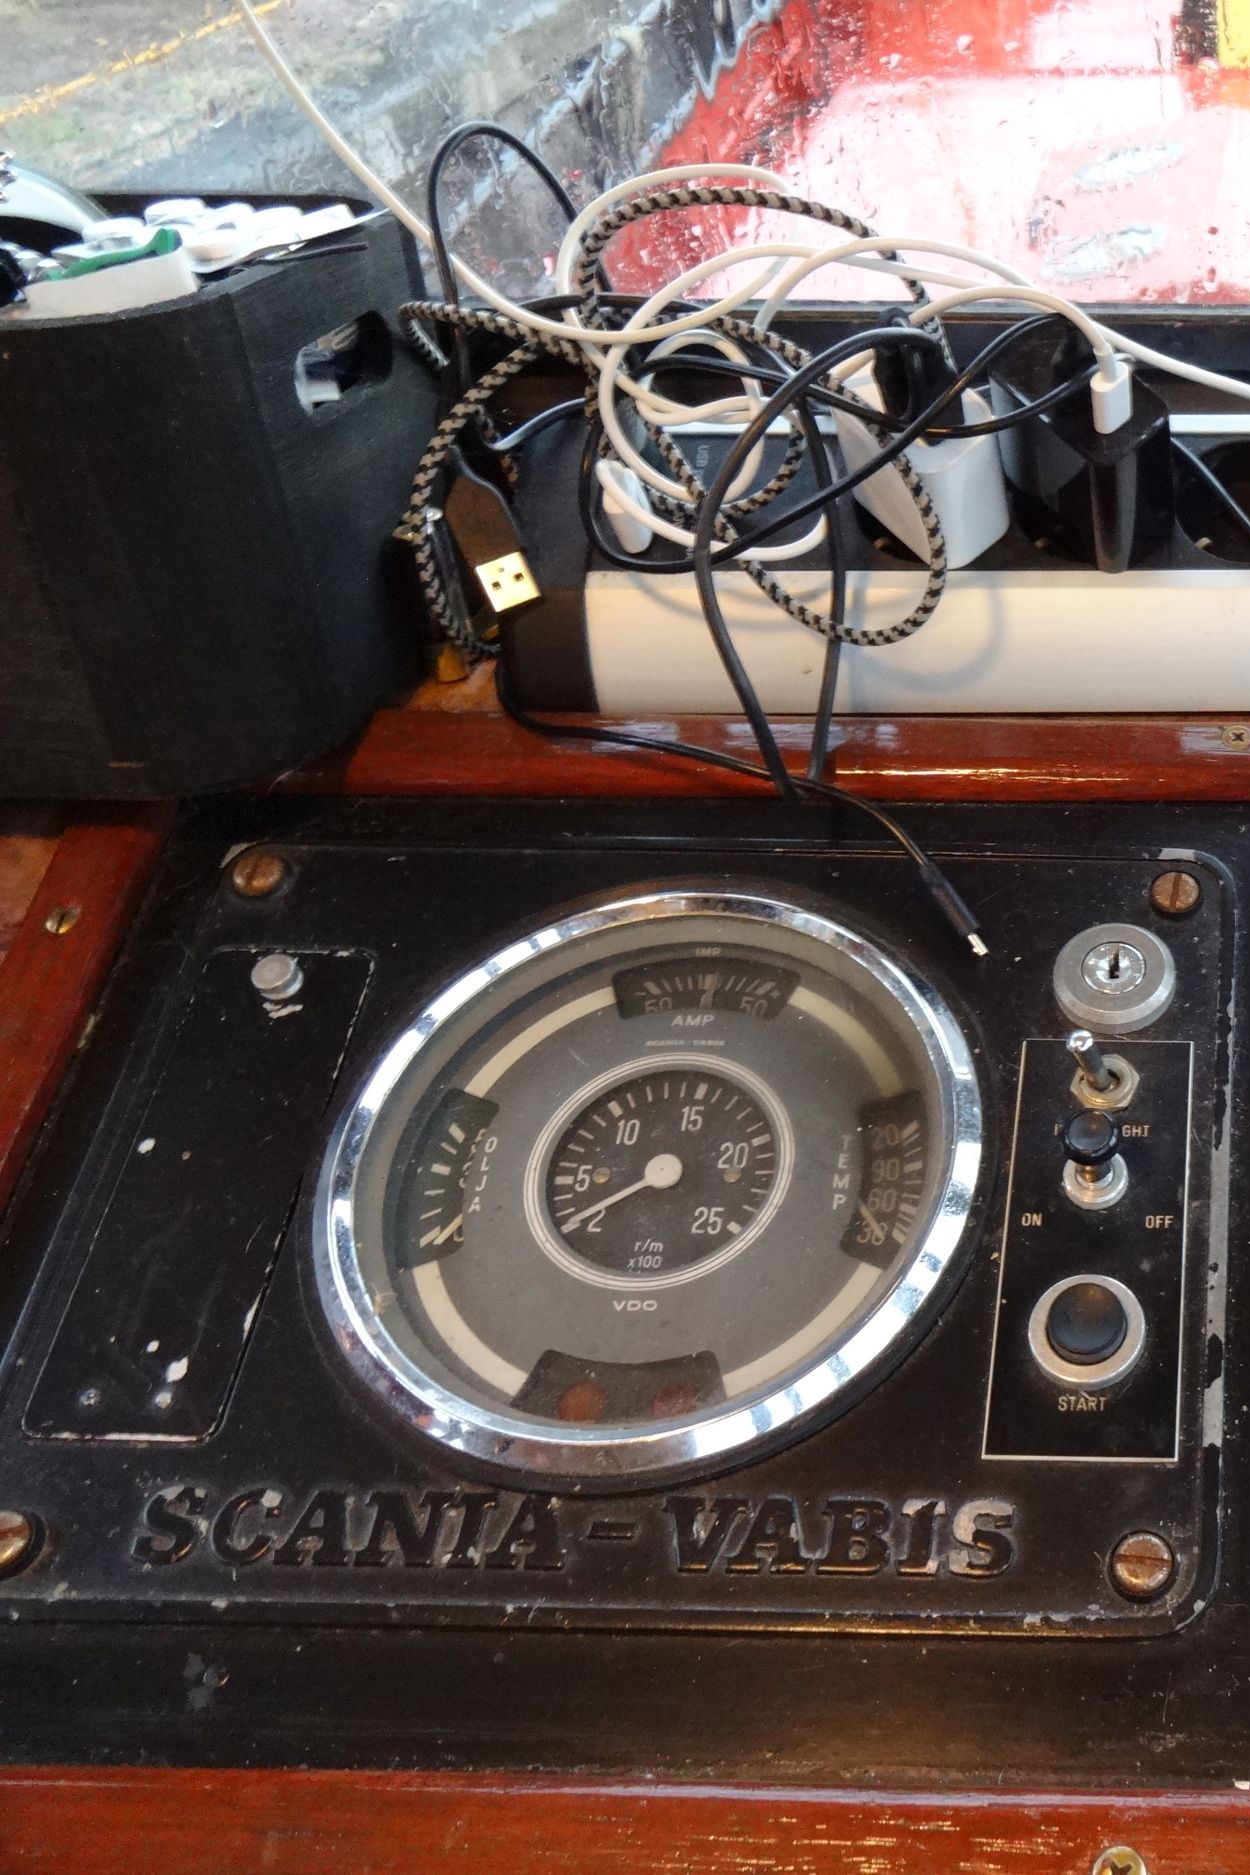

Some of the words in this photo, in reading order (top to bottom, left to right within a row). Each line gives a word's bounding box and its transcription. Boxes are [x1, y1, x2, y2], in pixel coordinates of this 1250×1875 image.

[739, 996, 769, 1016] 50
[671, 1014, 716, 1027] AMP
[680, 1105, 705, 1132] 15
[615, 1119, 641, 1146] 10
[1121, 1125, 1151, 1138] GHT
[717, 1141, 749, 1169] 20
[467, 1135, 498, 1214] OLJA
[574, 1165, 593, 1192] 5
[832, 1134, 853, 1210] TEMP
[587, 1207, 606, 1233] 2
[691, 1206, 725, 1235] 25
[1021, 1212, 1043, 1227] ON
[1145, 1215, 1175, 1229] OFF
[633, 1238, 664, 1252] r/m
[627, 1255, 663, 1269] x100
[613, 1300, 658, 1312] VDO
[1057, 1395, 1107, 1412] START
[129, 1485, 568, 1573] SCANIA
[662, 1494, 1016, 1578] VABIS
